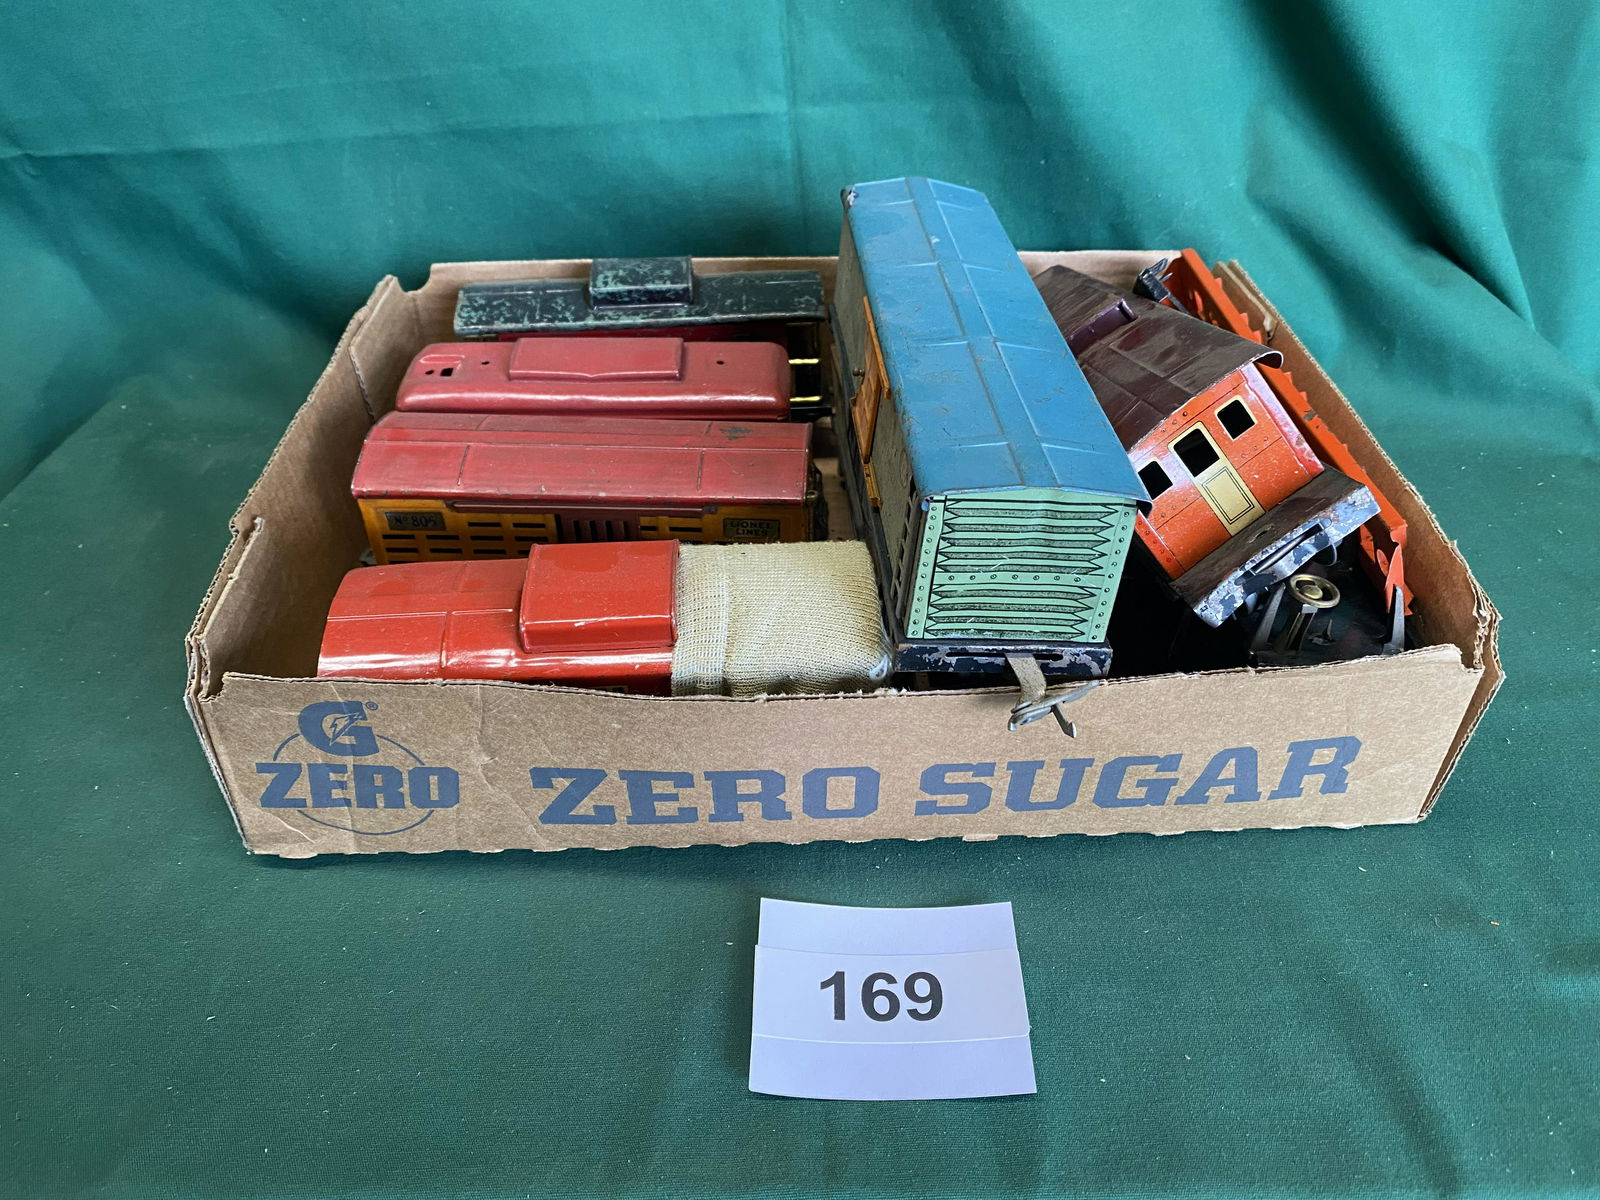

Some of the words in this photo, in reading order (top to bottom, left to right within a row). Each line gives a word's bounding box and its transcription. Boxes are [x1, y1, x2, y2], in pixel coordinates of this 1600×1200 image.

[730, 520, 772, 529] LIONEL
[735, 528, 769, 537] LINES
[255, 762, 460, 809] ZERO
[529, 765, 881, 825] ZERO
[914, 736, 1363, 817] SUGAR
[820, 971, 943, 1022] 169
